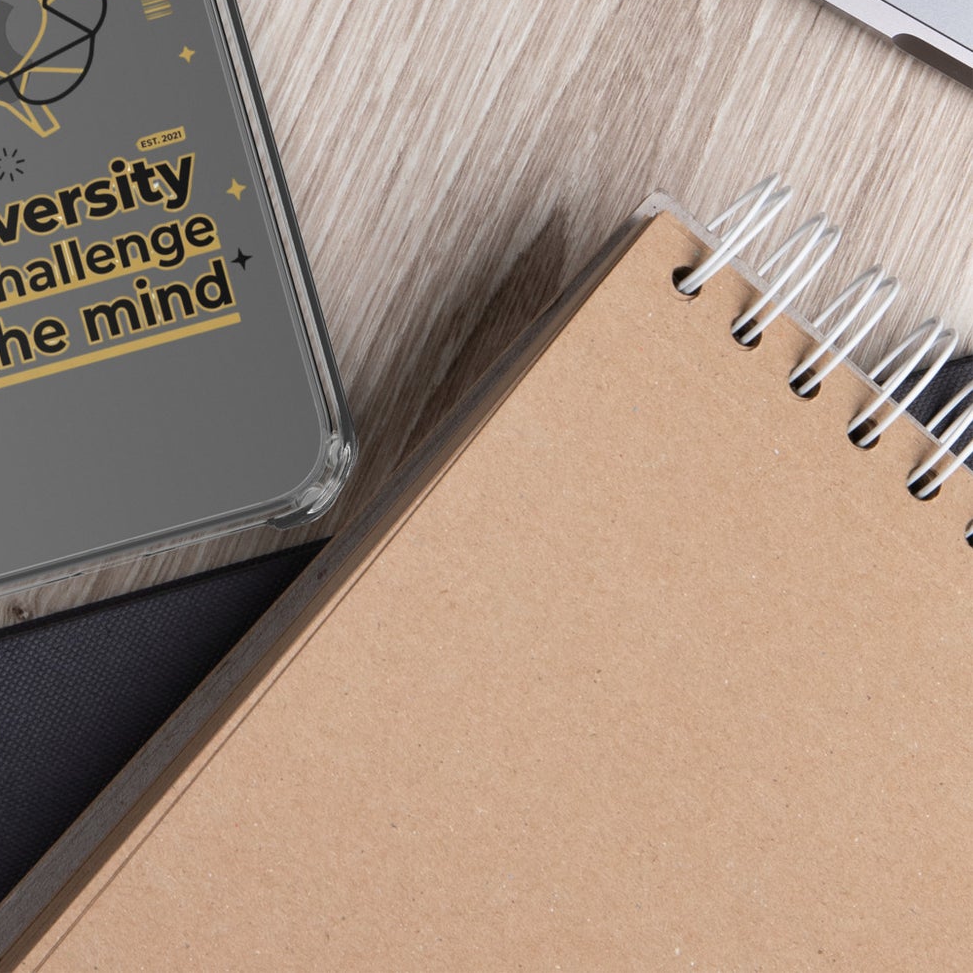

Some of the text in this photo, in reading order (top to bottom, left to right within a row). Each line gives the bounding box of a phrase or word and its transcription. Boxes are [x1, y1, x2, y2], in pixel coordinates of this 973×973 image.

[140, 130, 182, 148] EST. 2021
[80, 258, 236, 345] mind
